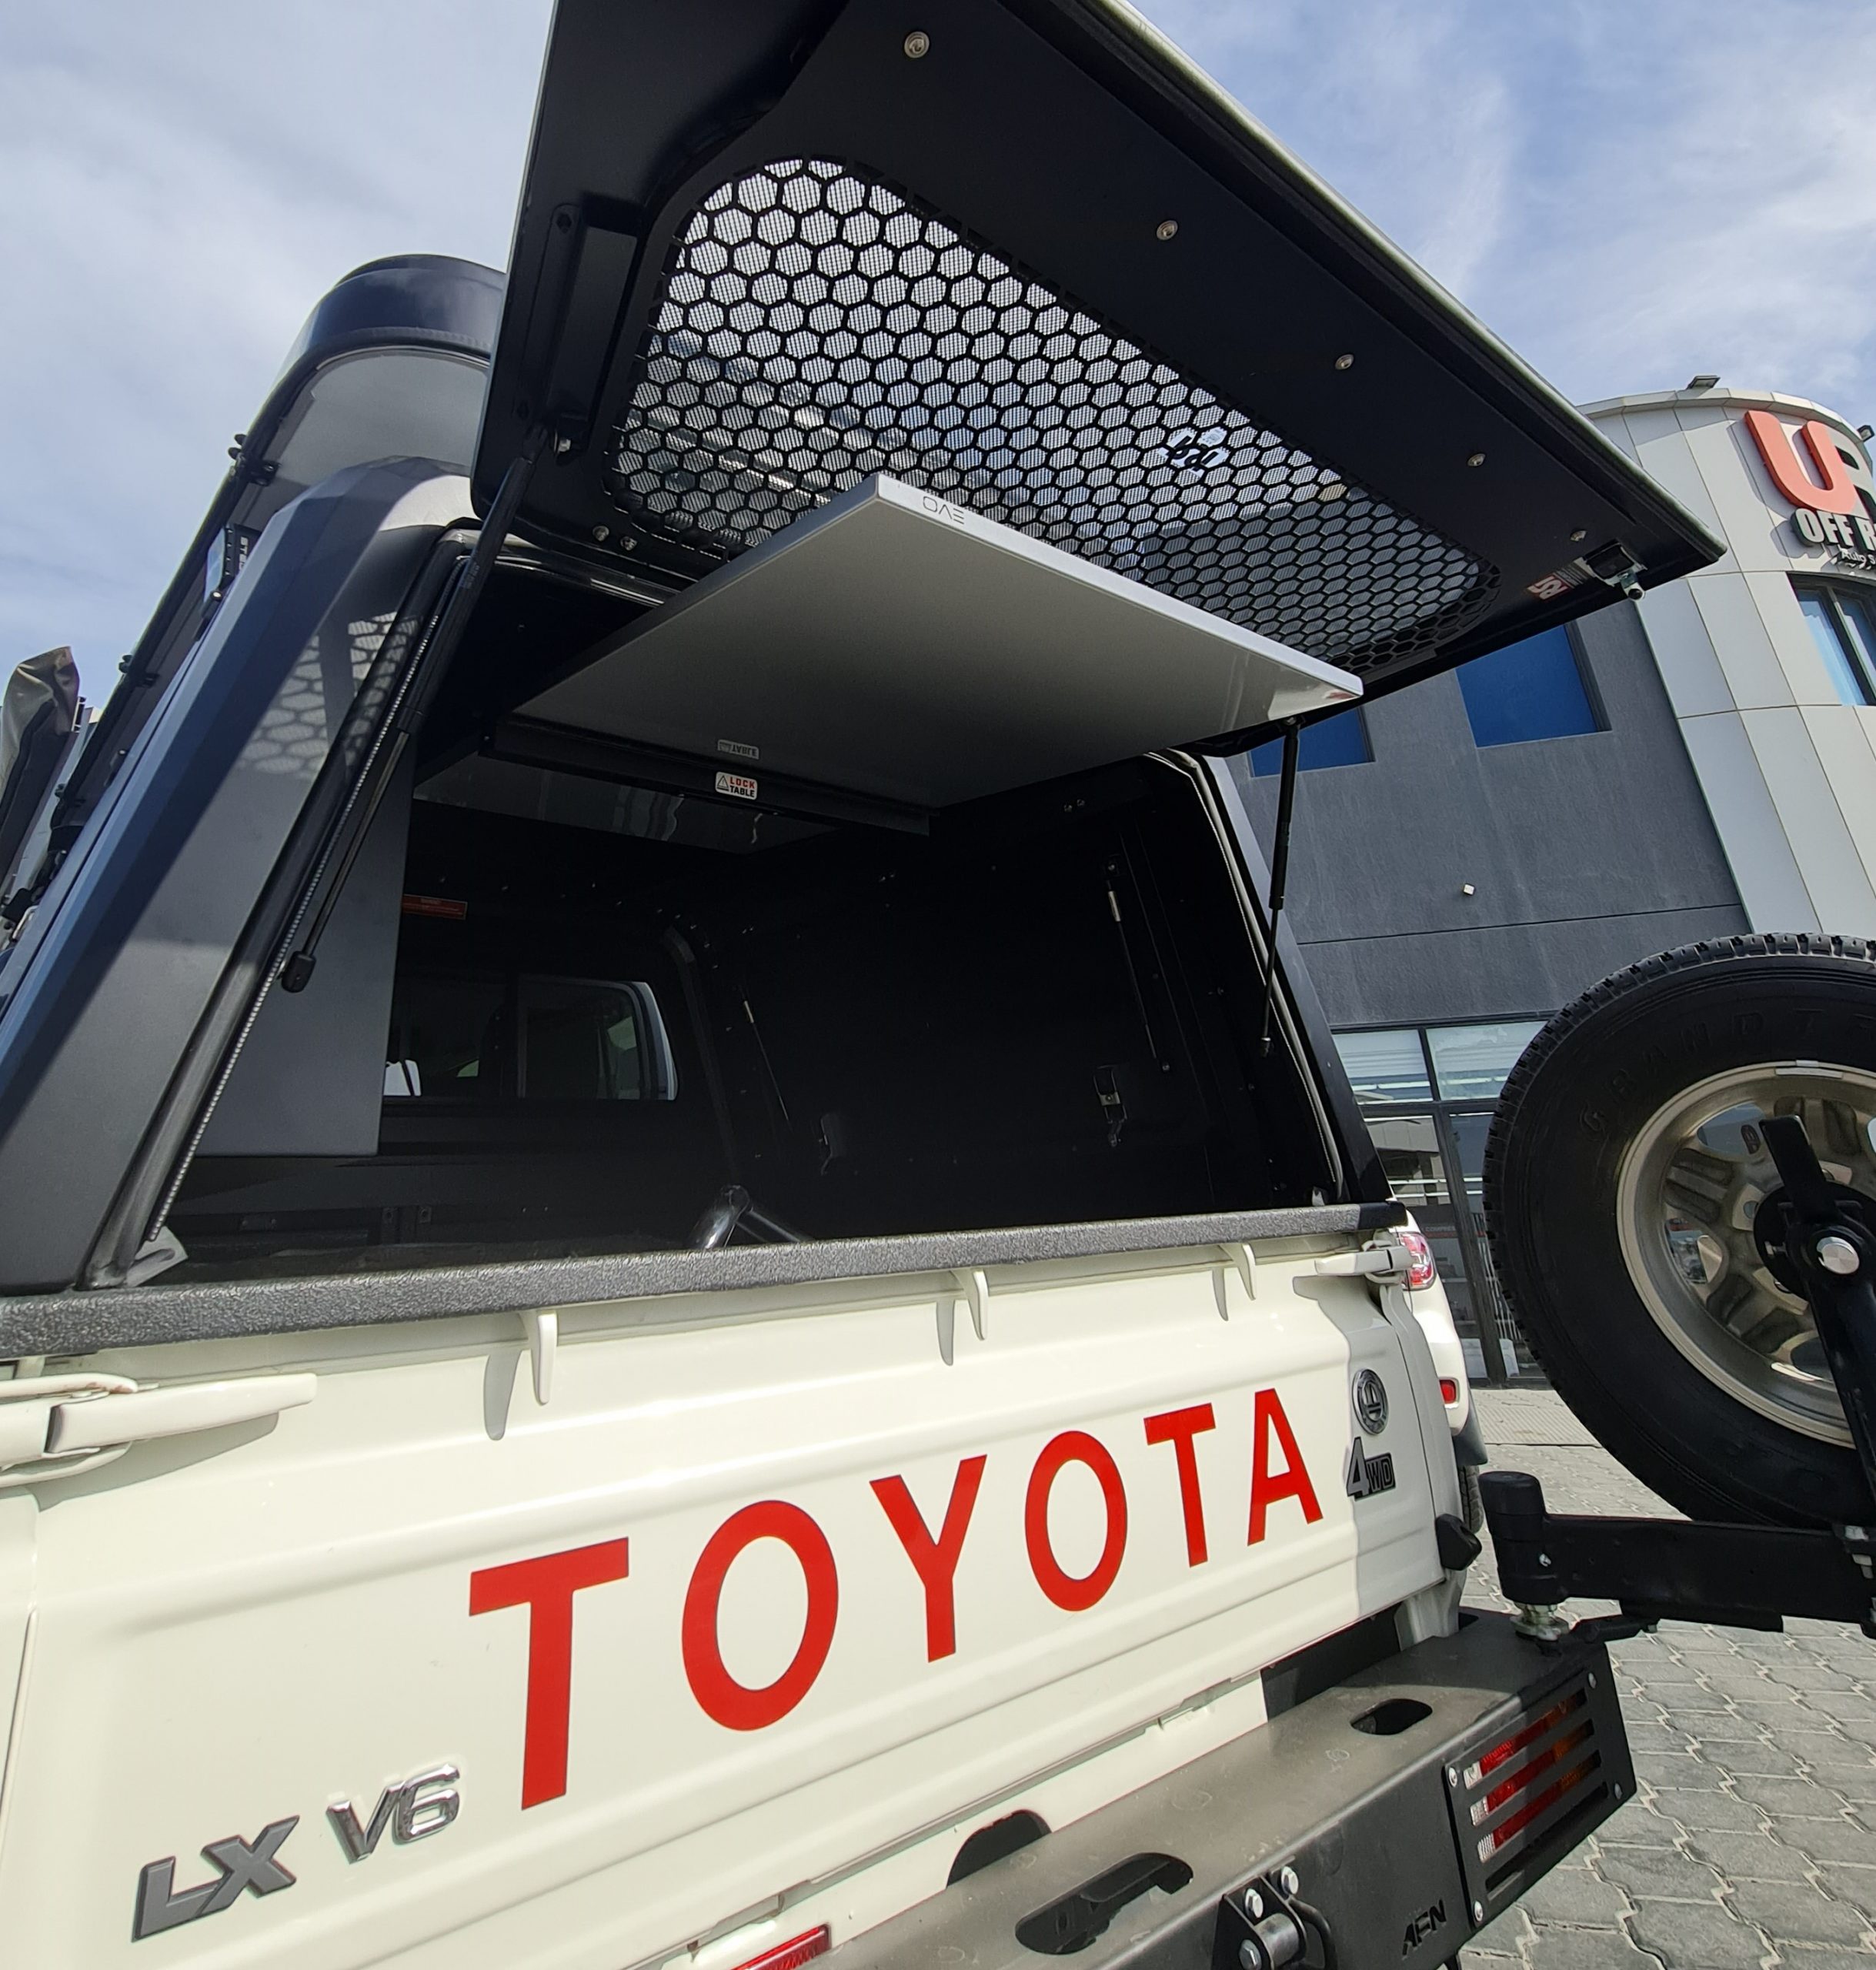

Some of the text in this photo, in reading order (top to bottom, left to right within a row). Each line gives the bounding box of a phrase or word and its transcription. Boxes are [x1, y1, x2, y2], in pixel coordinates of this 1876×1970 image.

[1793, 508, 1854, 548] OFF
[1841, 547, 1867, 565] Auto
[729, 776, 755, 790] LOCK
[729, 785, 755, 798] TABLE
[1347, 1436, 1397, 1501] 4WD
[469, 1387, 1324, 1810] TOYOTA
[132, 1763, 461, 1943] LX V6
